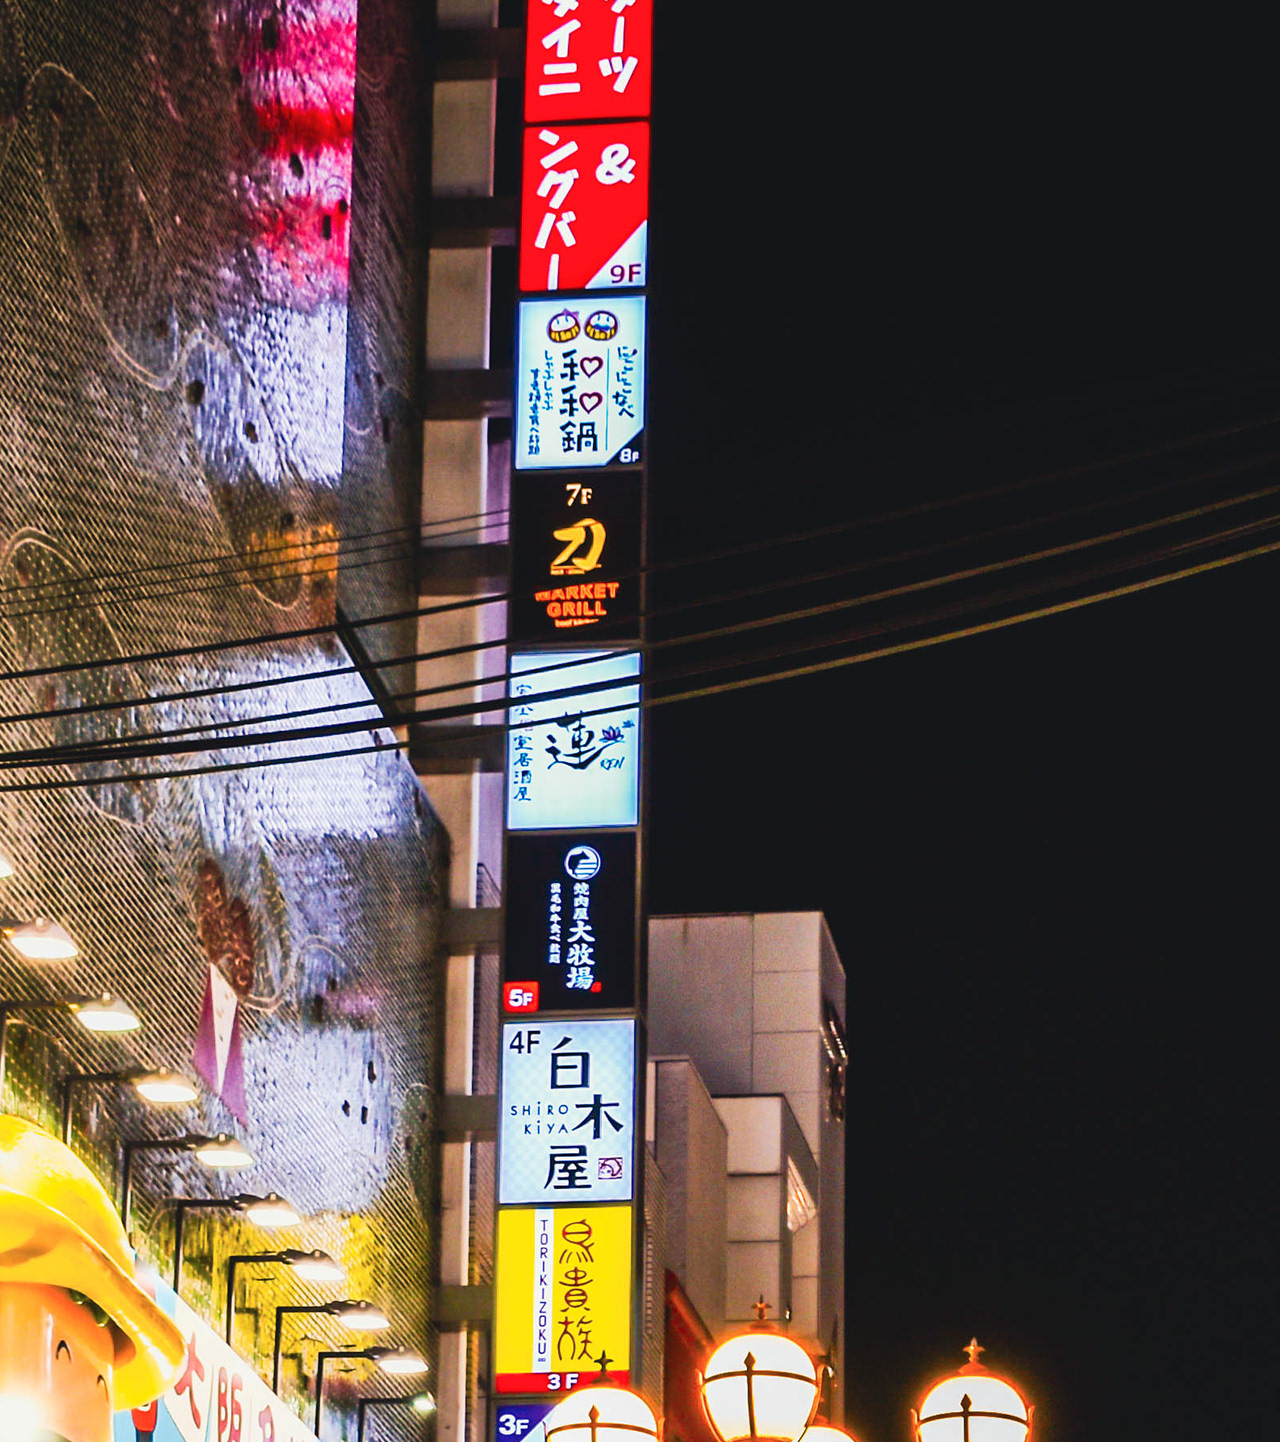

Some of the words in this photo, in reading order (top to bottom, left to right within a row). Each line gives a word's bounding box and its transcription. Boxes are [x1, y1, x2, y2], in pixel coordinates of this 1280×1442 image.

[610, 264, 642, 284] 9F
[620, 449, 640, 463] 8F
[566, 483, 593, 506] 7F
[534, 582, 620, 602] MARKET
[546, 600, 607, 618] GRILL
[509, 989, 534, 1007] 5F
[509, 1030, 541, 1054] 4F
[543, 1036, 625, 1190] 白木屋
[537, 1218, 549, 1355] TORIKIZOKU
[547, 1373, 579, 1391] 3F
[499, 1414, 530, 1436] 3F
